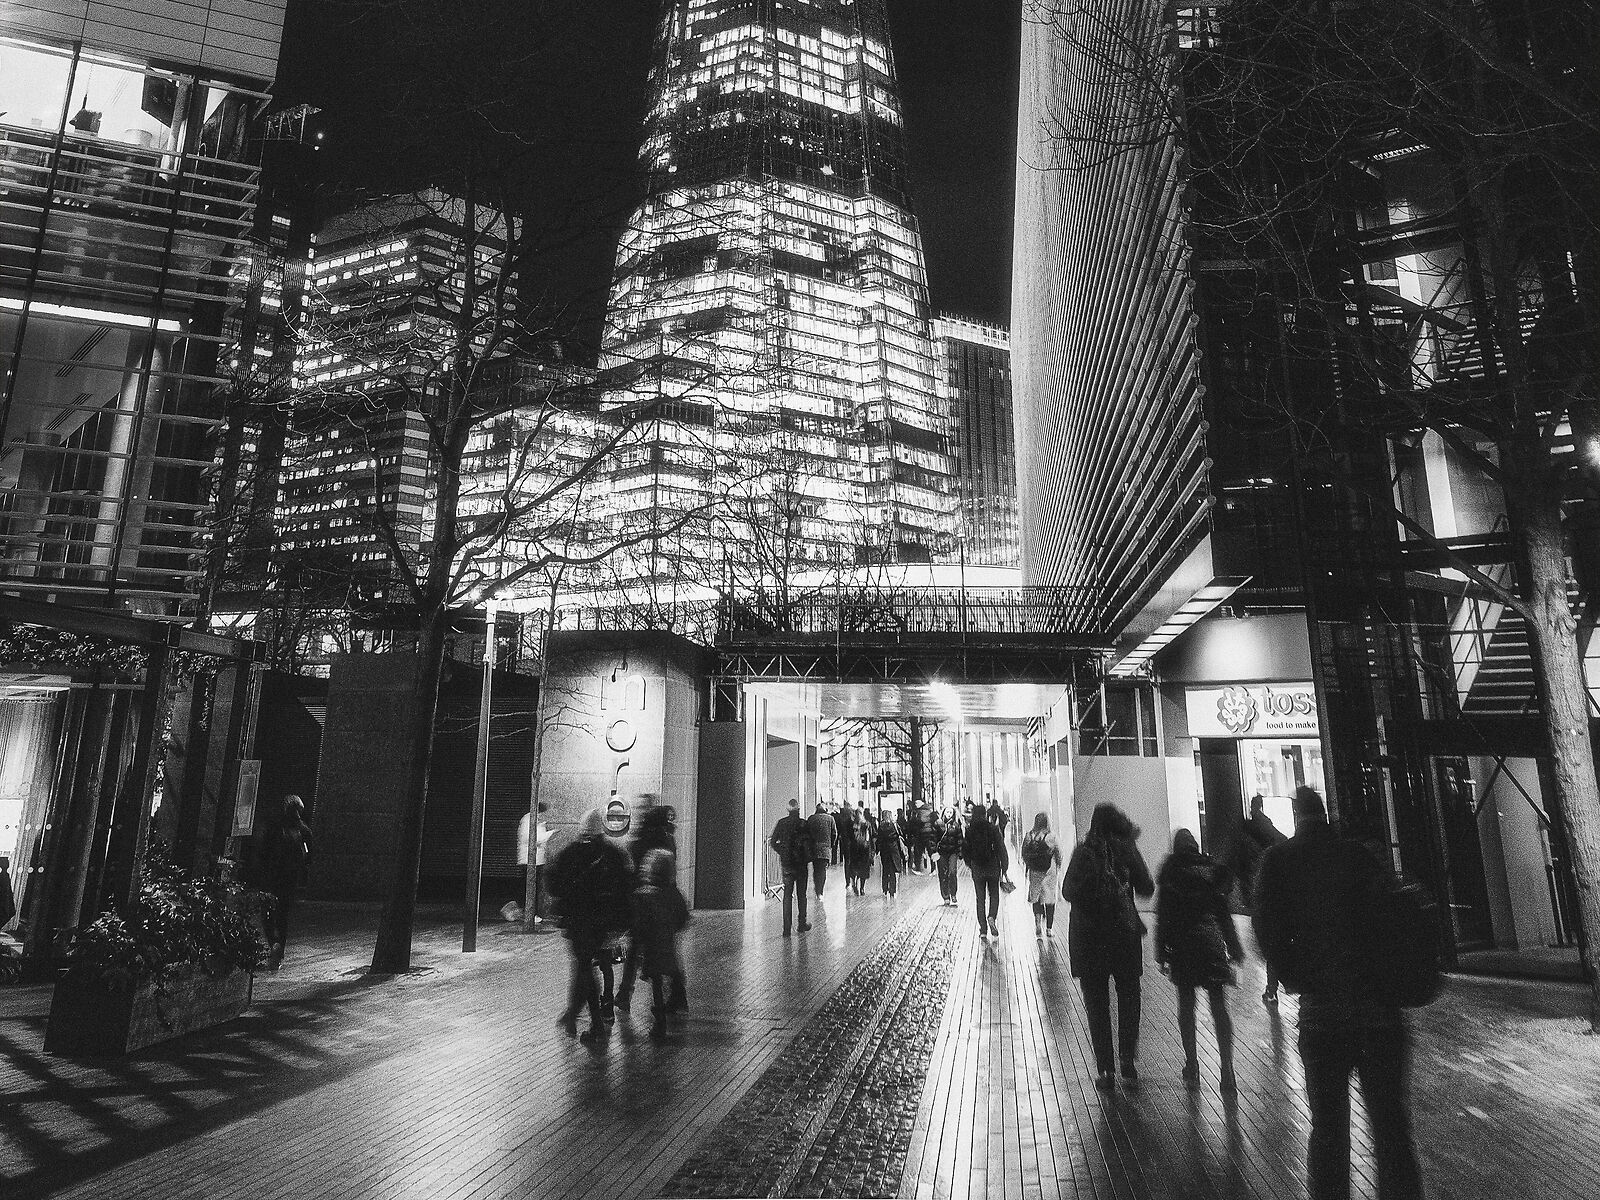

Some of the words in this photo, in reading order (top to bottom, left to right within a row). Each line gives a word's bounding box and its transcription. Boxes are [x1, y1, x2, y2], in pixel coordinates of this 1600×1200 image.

[601, 674, 647, 837] more
[1266, 721, 1283, 729] food
[1285, 721, 1294, 729] to
[1295, 720, 1316, 729] make
